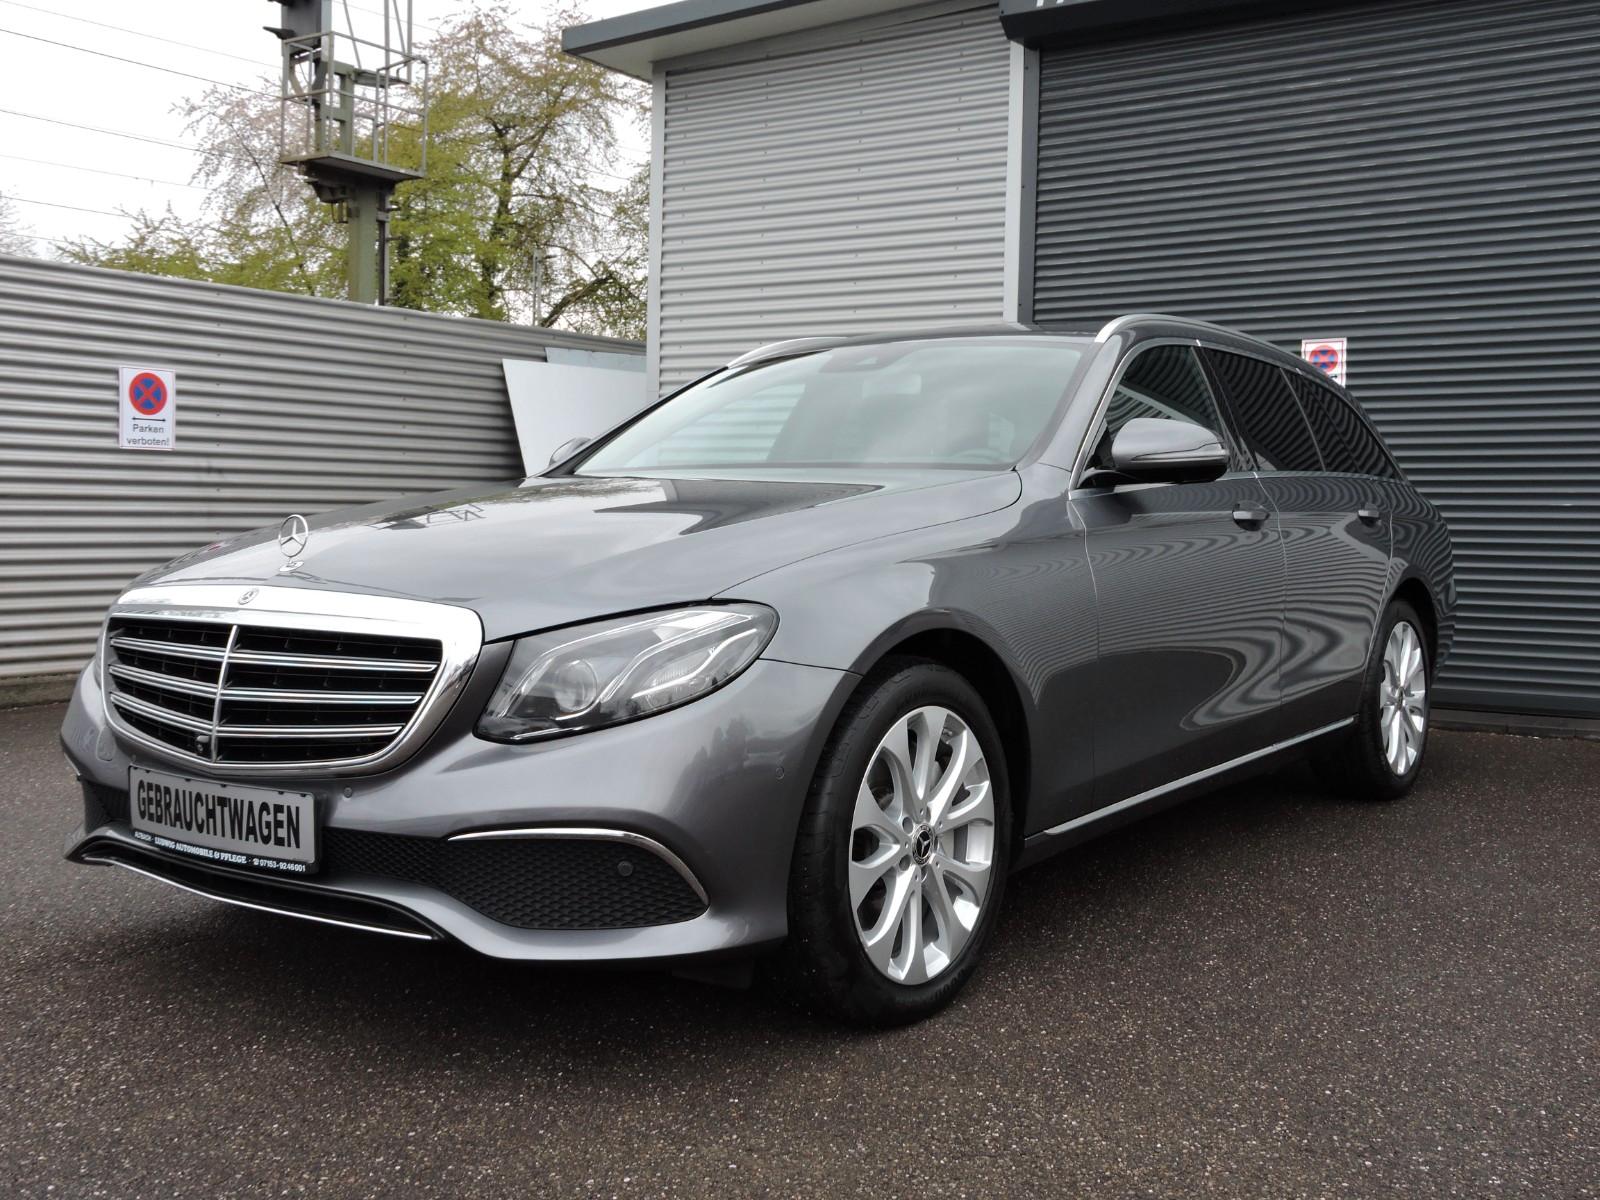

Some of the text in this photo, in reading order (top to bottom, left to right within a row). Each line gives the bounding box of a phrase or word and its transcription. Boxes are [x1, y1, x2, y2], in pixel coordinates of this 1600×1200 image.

[133, 424, 164, 432] Parken
[127, 437, 169, 446] verboten!
[137, 779, 300, 848] GEBRAUCHTWAGEN
[154, 836, 176, 848] LUDWIG
[175, 842, 214, 858] AUTOMOBILE
[220, 852, 247, 864] PFLEGE
